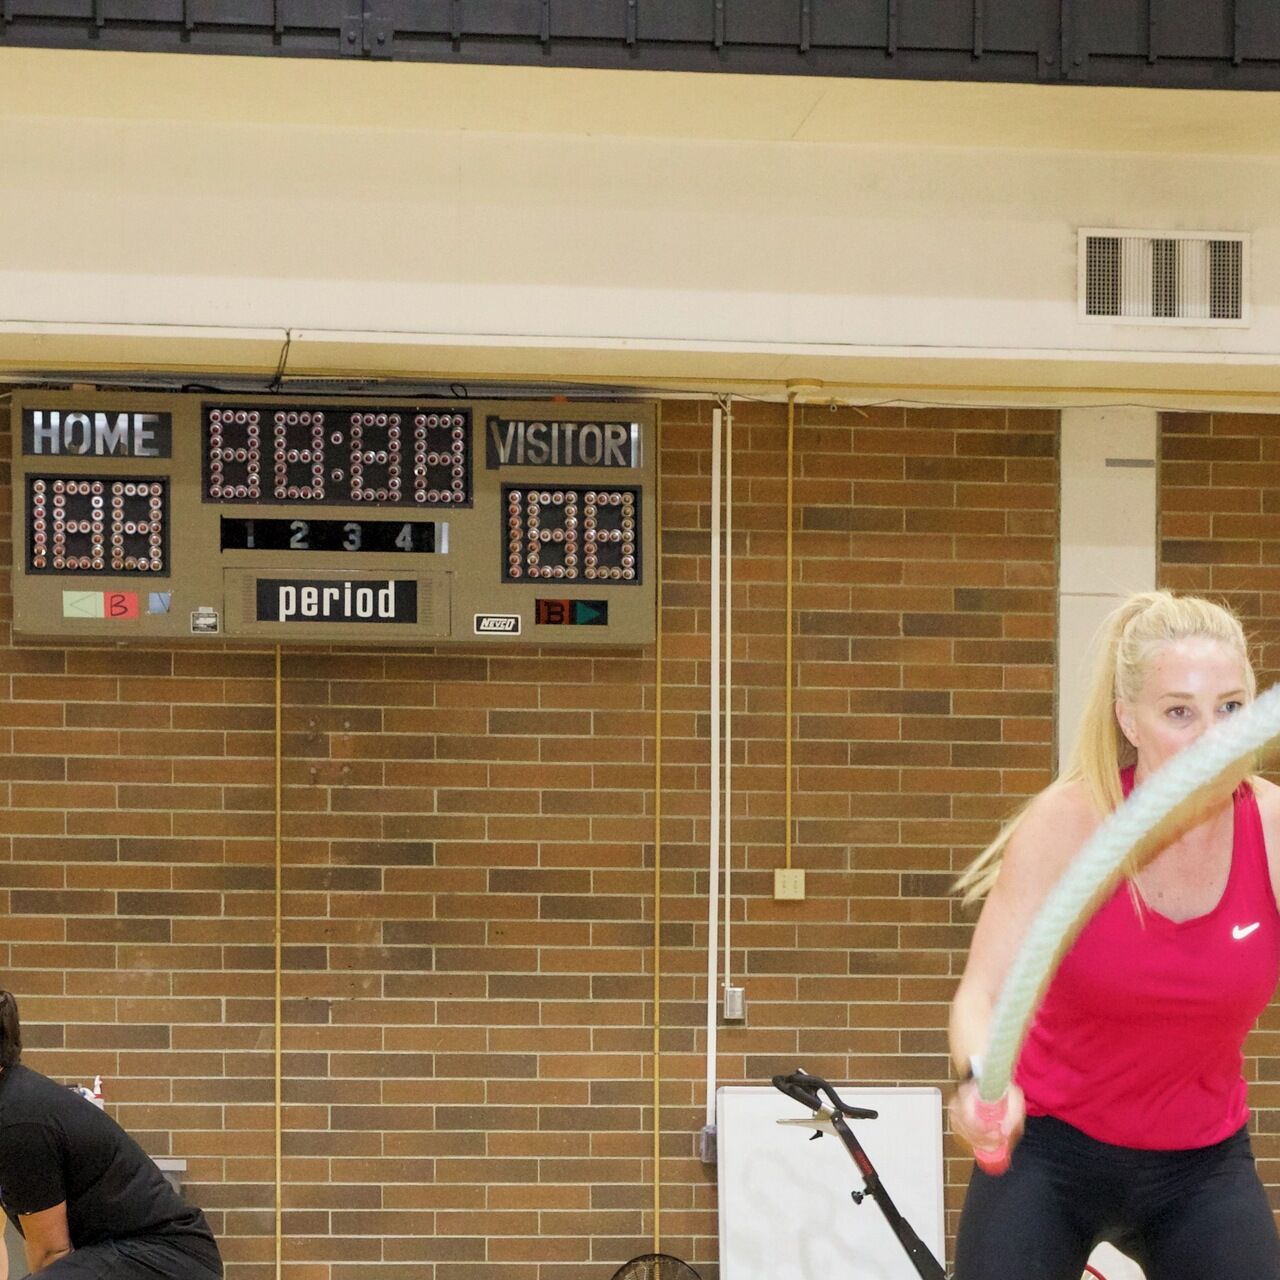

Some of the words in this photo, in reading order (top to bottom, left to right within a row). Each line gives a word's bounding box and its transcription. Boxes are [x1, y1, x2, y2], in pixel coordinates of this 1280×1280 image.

[33, 411, 160, 457] HOME
[490, 421, 628, 466] VISITOR
[289, 520, 309, 549] 2
[343, 521, 362, 551] 3
[394, 523, 414, 552] 4
[110, 594, 128, 617] B
[279, 580, 395, 622] period
